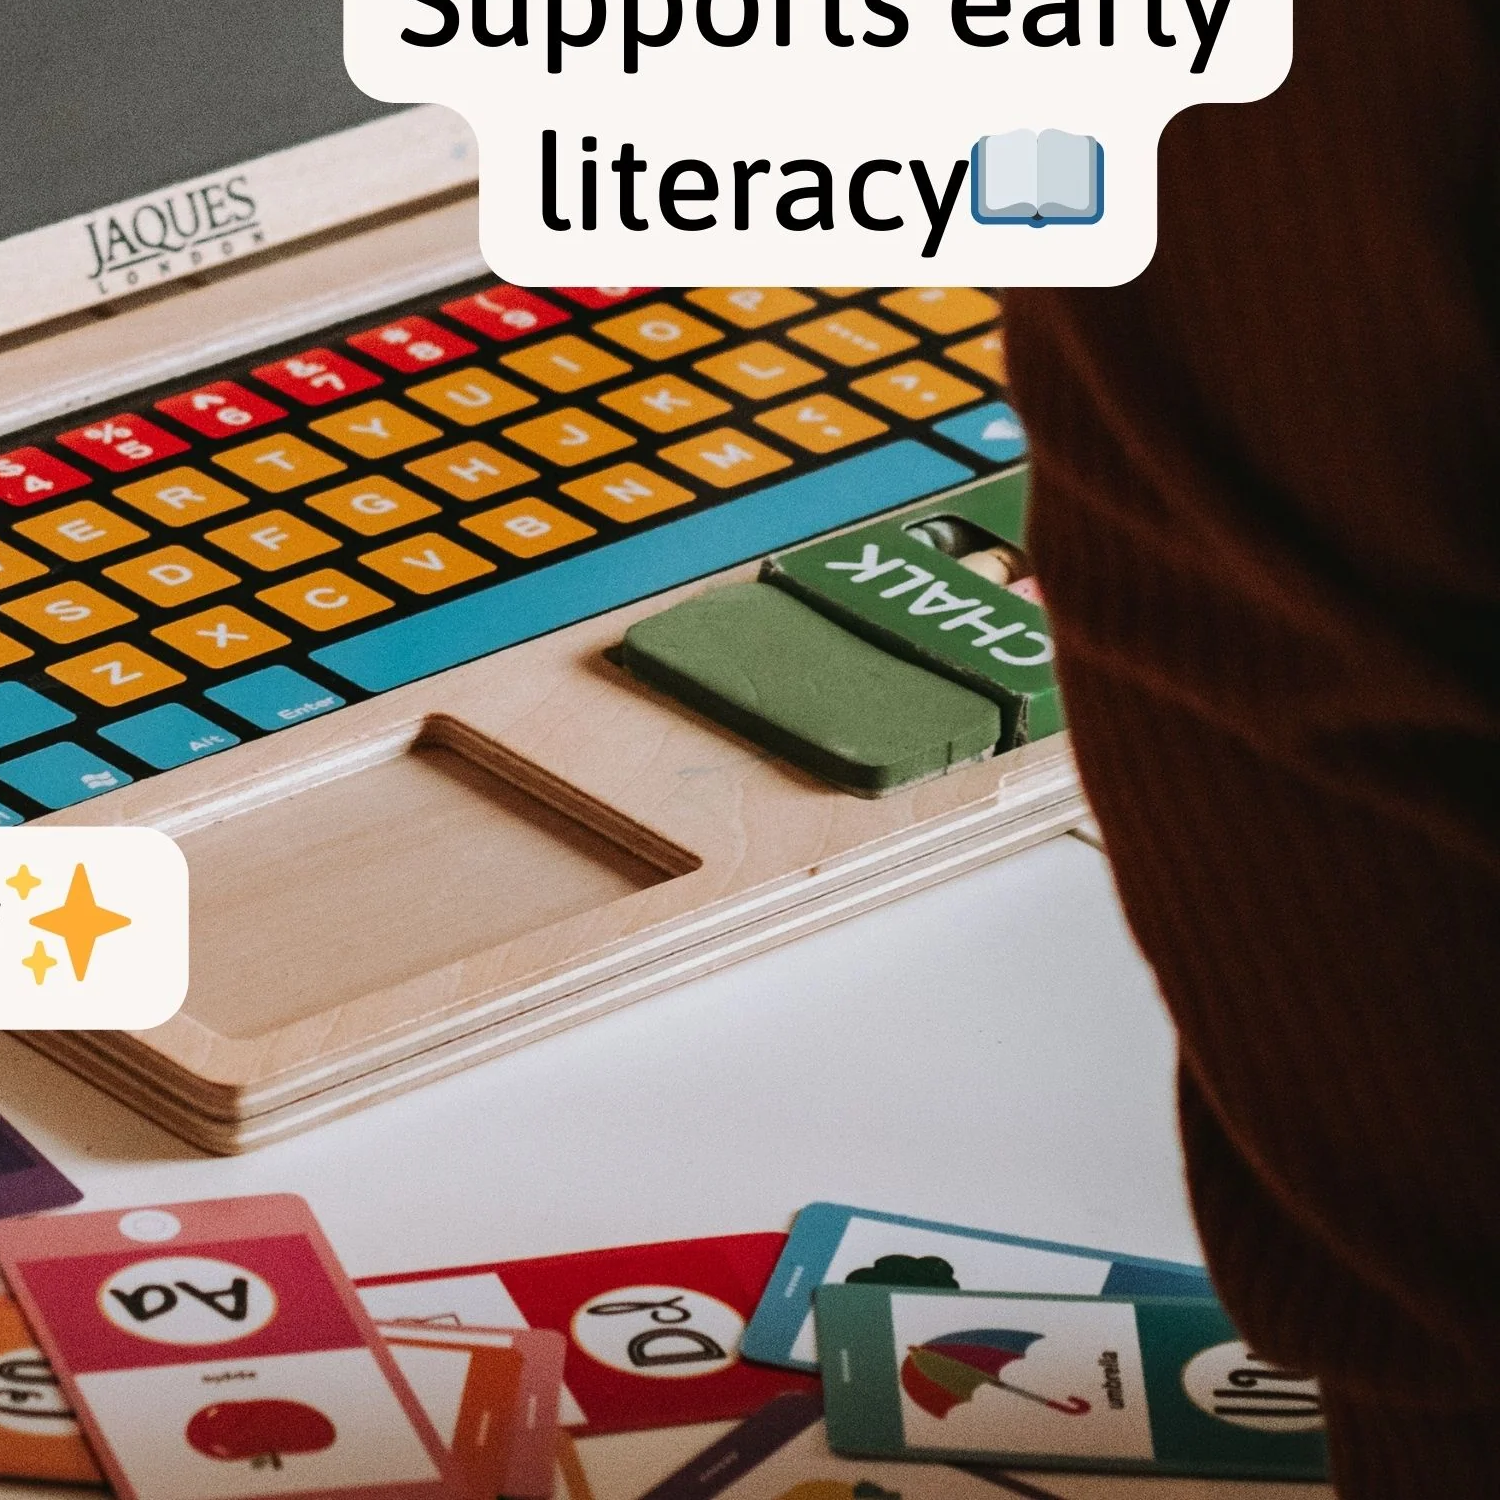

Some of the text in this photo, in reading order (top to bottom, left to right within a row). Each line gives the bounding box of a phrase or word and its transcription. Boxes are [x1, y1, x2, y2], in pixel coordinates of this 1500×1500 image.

[85, 175, 257, 280] JAQUES
[97, 230, 265, 296] LONDON
[639, 320, 682, 342] O
[738, 362, 786, 380] L
[446, 384, 493, 408] U
[643, 389, 690, 413] K
[350, 417, 389, 438] Y
[560, 423, 590, 446] J
[255, 450, 295, 471] T
[700, 443, 753, 469] M
[448, 457, 499, 483] H
[156, 485, 205, 510] R
[603, 478, 653, 504] N
[350, 492, 398, 515] G
[57, 518, 106, 543] E
[250, 526, 288, 551] F
[504, 515, 551, 539] B
[403, 549, 445, 572] V
[147, 563, 194, 586] D
[304, 586, 349, 610] C
[825, 543, 1054, 666] CHALK
[44, 599, 92, 622] S
[196, 622, 248, 649] X
[92, 660, 143, 686] Z
[278, 695, 335, 720] Enter
[189, 733, 225, 752] Alt
[109, 1277, 249, 1322] Aa
[587, 1295, 727, 1368] Dd
